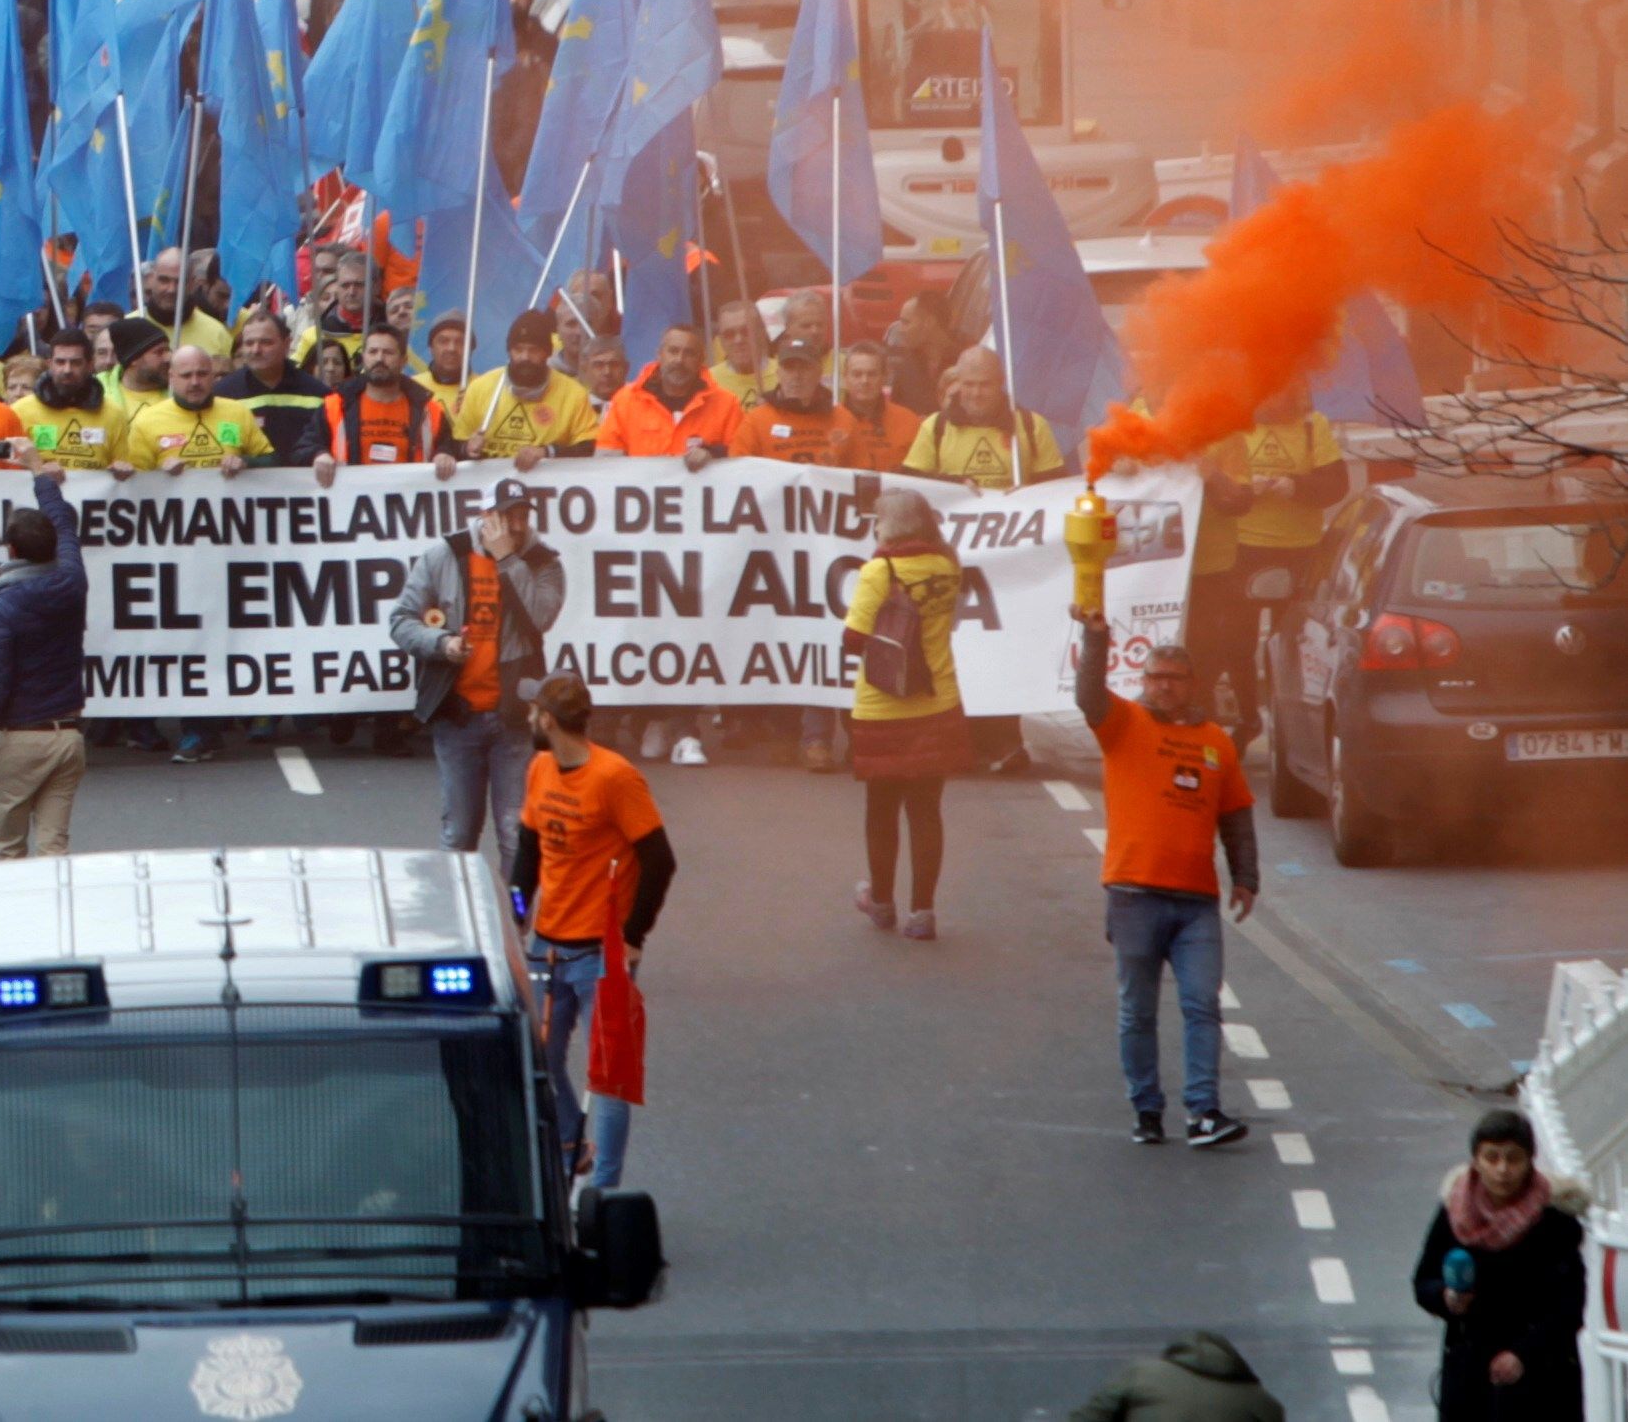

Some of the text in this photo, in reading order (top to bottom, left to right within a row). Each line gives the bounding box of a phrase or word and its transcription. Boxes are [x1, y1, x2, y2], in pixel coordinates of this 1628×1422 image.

[911, 76, 1015, 99] ARTEIO
[614, 485, 684, 535] DE
[702, 485, 771, 534] LA
[111, 562, 203, 631] EL
[592, 549, 705, 619] EN
[226, 653, 292, 697] DE
[739, 642, 859, 689] AVILE
[1523, 732, 1585, 757] 0784
